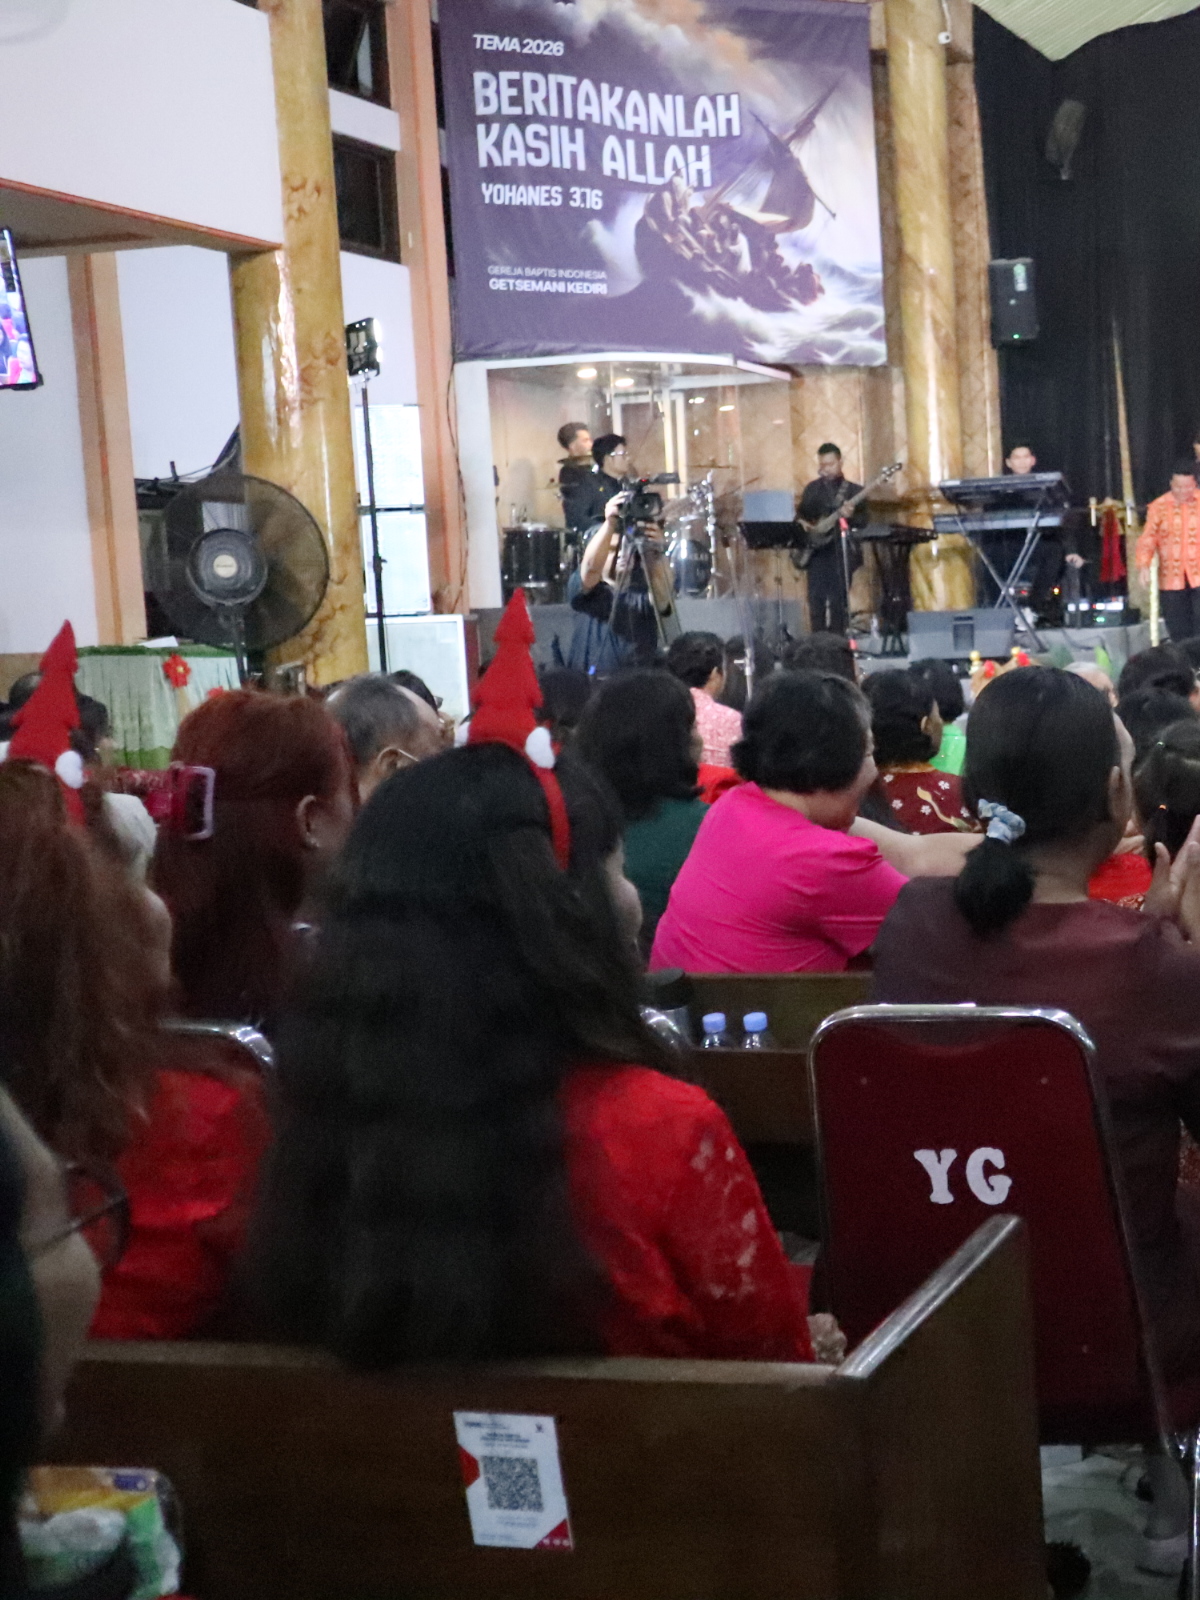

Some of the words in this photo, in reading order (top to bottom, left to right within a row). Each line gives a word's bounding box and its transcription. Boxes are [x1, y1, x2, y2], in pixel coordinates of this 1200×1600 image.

[473, 34, 520, 52] TEMA
[522, 38, 564, 56] 2026
[473, 71, 741, 138] BERITAKANLAH
[476, 123, 586, 171] KASIH
[602, 134, 712, 188] ALLAH
[481, 182, 562, 207] YOHANES
[487, 265, 523, 276] GEREJA
[524, 267, 557, 278] BAPTIS
[558, 269, 608, 280] INDONESIA
[489, 278, 565, 293] GETSEMANI
[567, 282, 608, 294] KEDIRI
[913, 1147, 1012, 1205] YG
